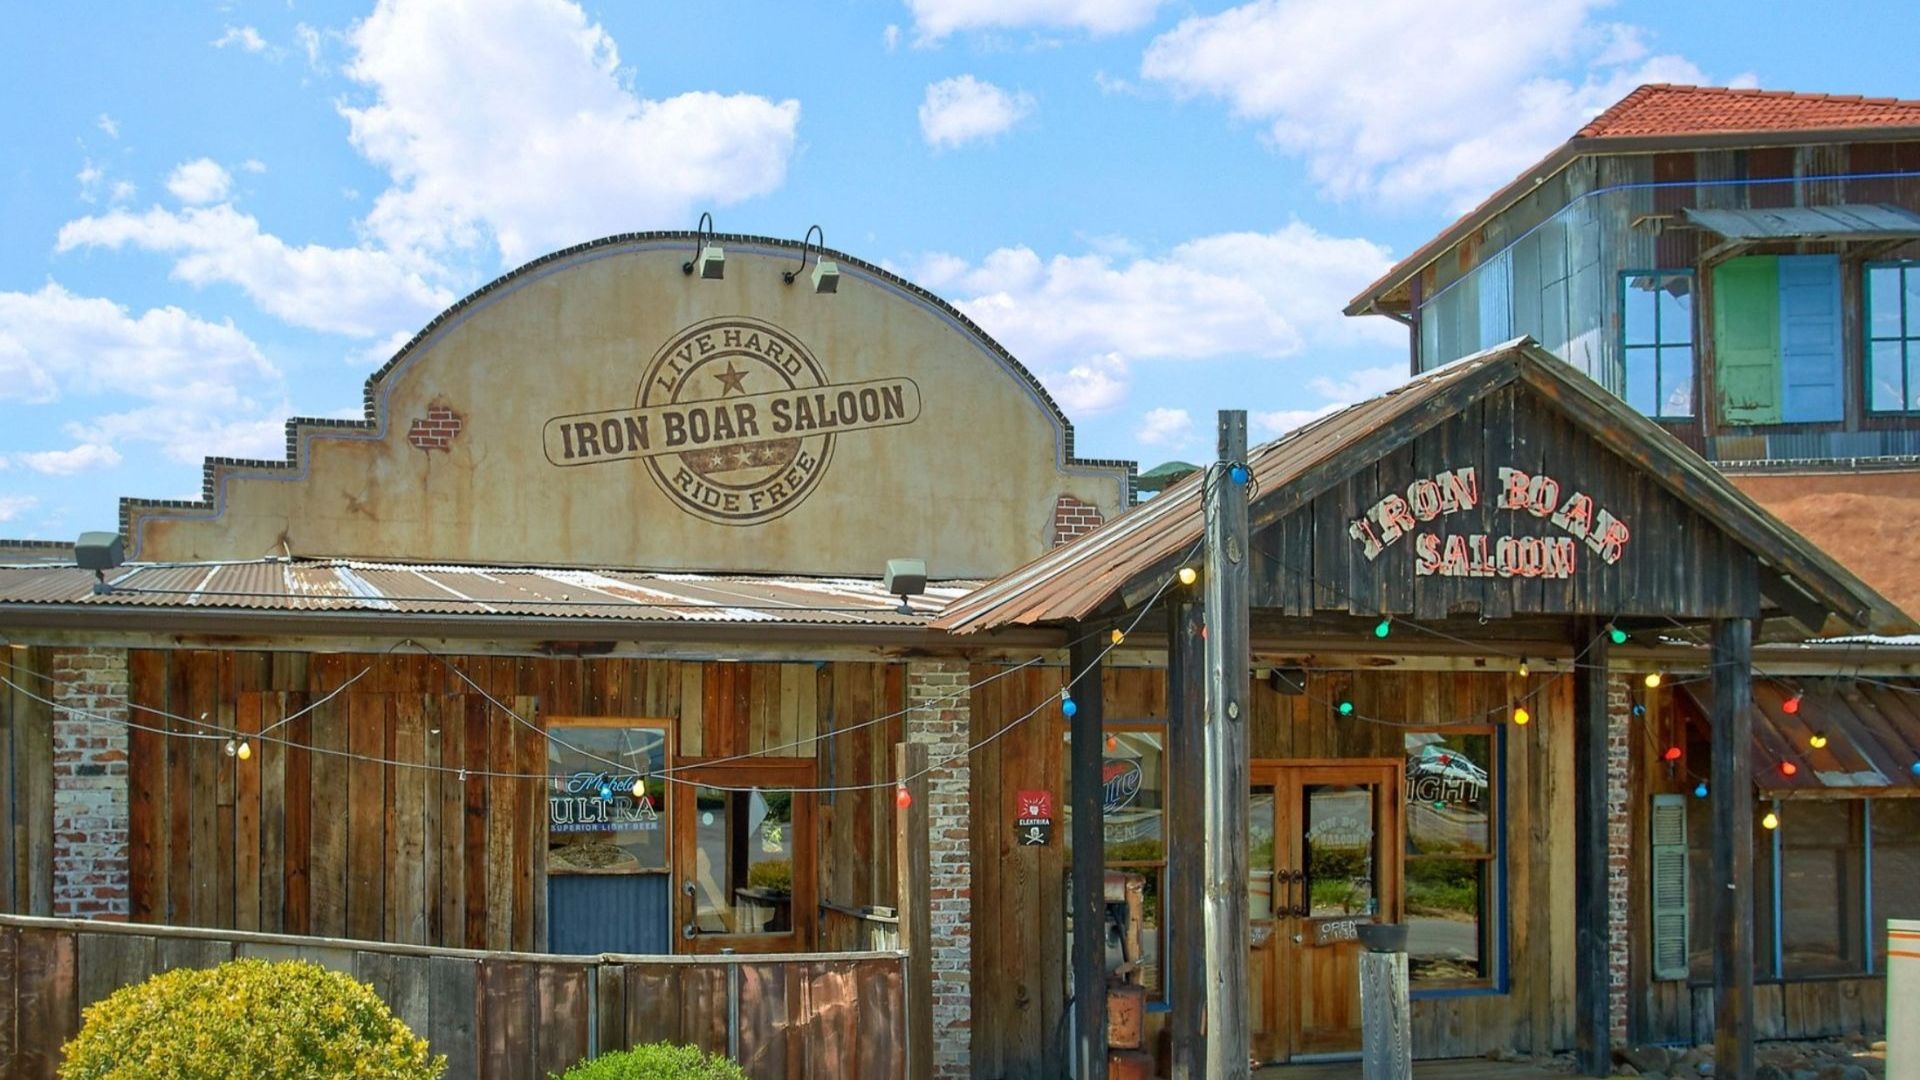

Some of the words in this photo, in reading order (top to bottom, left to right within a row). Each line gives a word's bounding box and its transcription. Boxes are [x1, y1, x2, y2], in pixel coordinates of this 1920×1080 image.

[657, 334, 716, 393] LIVE
[723, 330, 803, 378] HARD
[560, 415, 651, 459] IRON
[662, 402, 760, 447] BOAR
[772, 384, 906, 434] SALOON
[672, 466, 740, 512] RIDE
[749, 451, 817, 511] FREE
[1349, 466, 1478, 562] IRON
[1498, 467, 1630, 565] BOAR
[1415, 532, 1576, 579] SALOON
[1403, 776, 1481, 803] IGHT
[550, 796, 658, 825] ULTRA
[550, 824, 598, 832] SUPERIOR
[602, 823, 628, 831] LIGHT
[632, 822, 658, 831] BEER
[1103, 824, 1136, 843] PEN
[1321, 919, 1358, 933] OPEN
